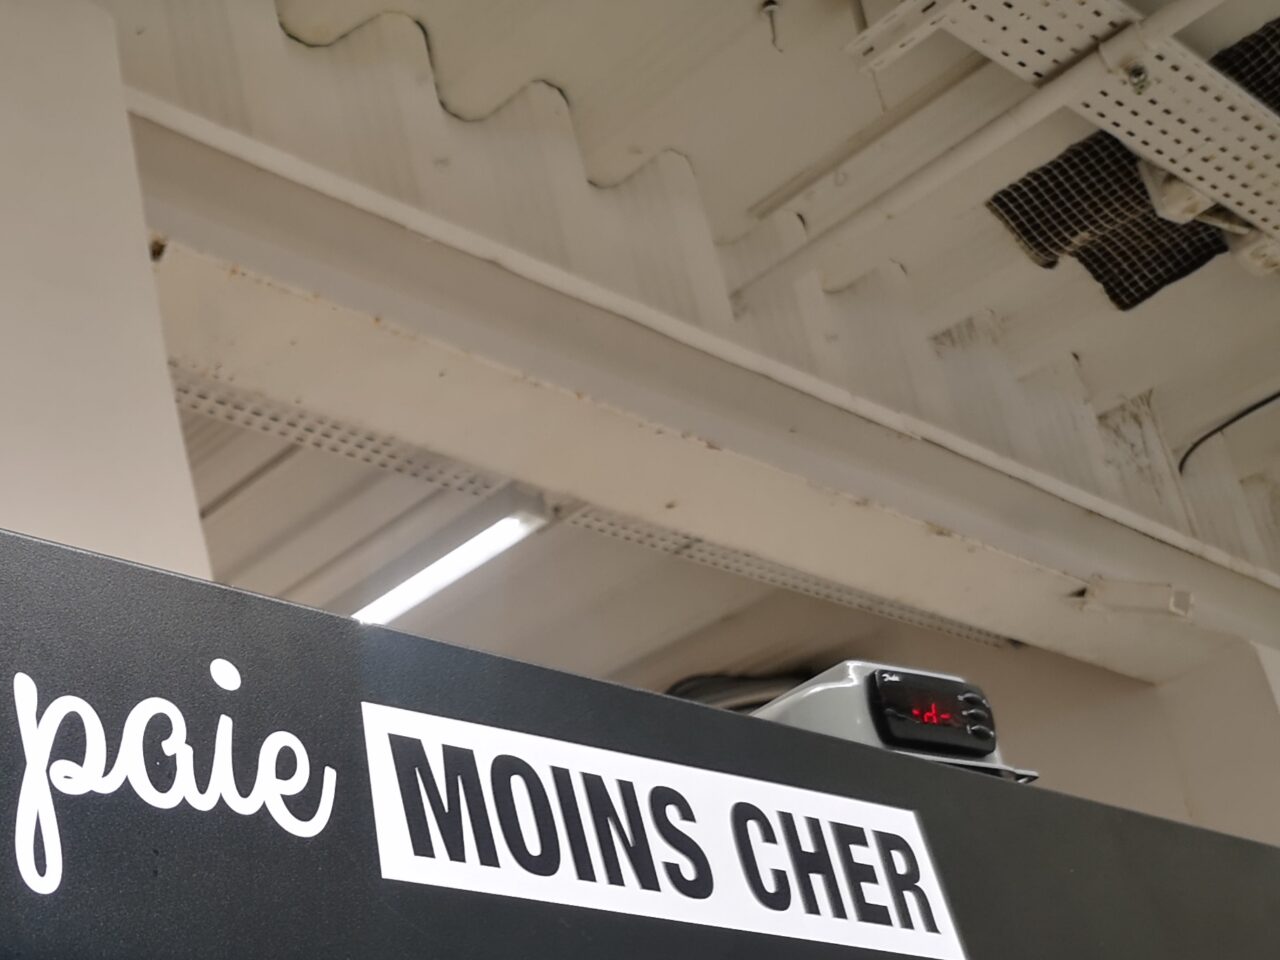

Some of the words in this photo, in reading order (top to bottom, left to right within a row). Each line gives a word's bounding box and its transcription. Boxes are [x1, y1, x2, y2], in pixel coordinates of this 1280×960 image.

[14, 658, 337, 894] paie
[388, 733, 715, 900] MOINS
[732, 801, 942, 935] CHER
